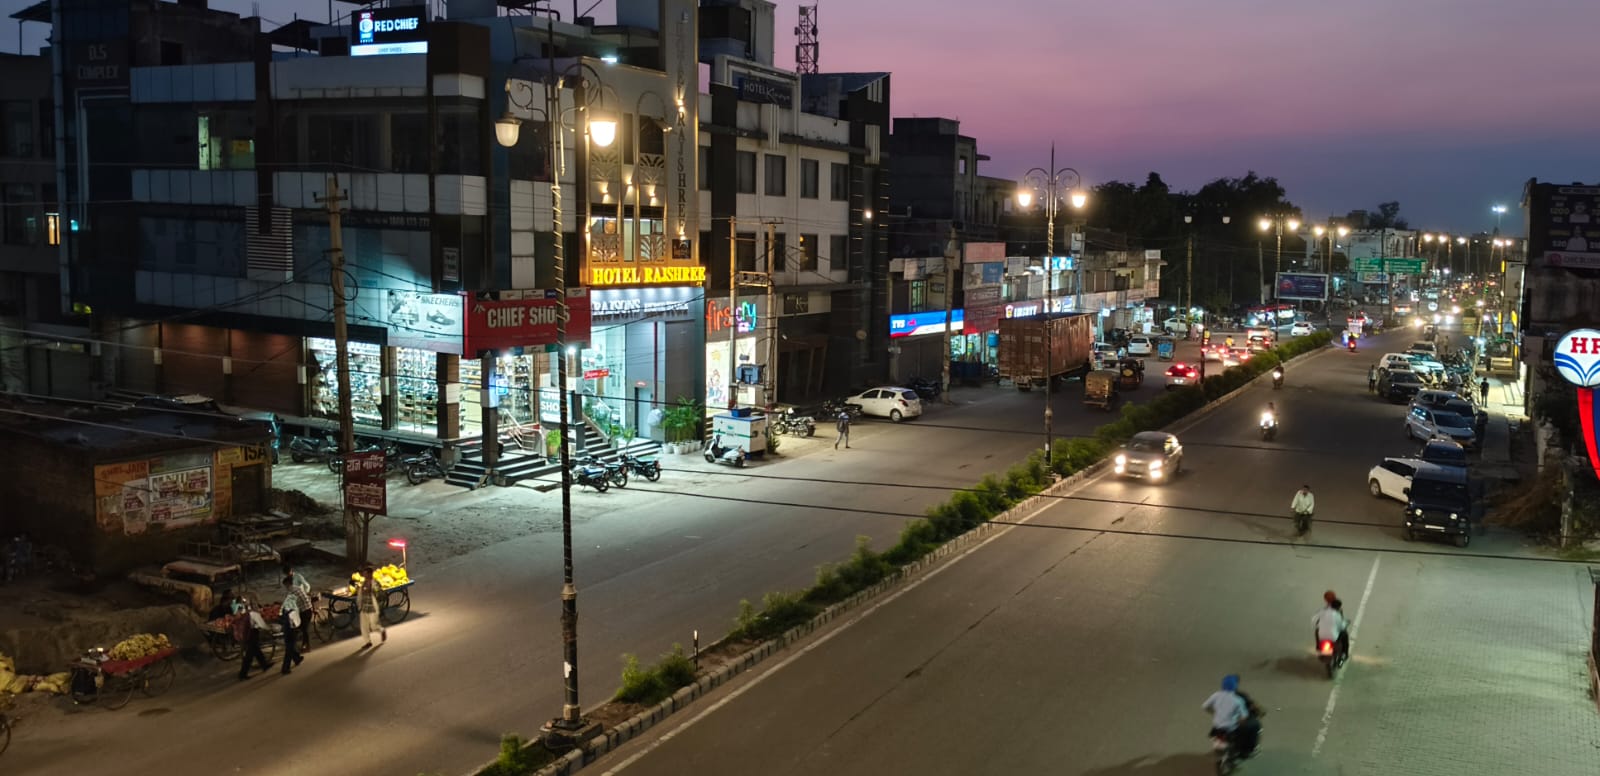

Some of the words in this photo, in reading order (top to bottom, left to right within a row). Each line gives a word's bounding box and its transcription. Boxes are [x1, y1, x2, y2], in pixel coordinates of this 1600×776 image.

[374, 20, 394, 32] RED
[394, 18, 419, 31] CHIEF
[592, 267, 641, 285] HOTEL
[643, 266, 706, 283] RAJSHREE
[420, 296, 459, 307] SKECHERS
[487, 307, 526, 328] CHIEF
[529, 304, 571, 325] SHOS
